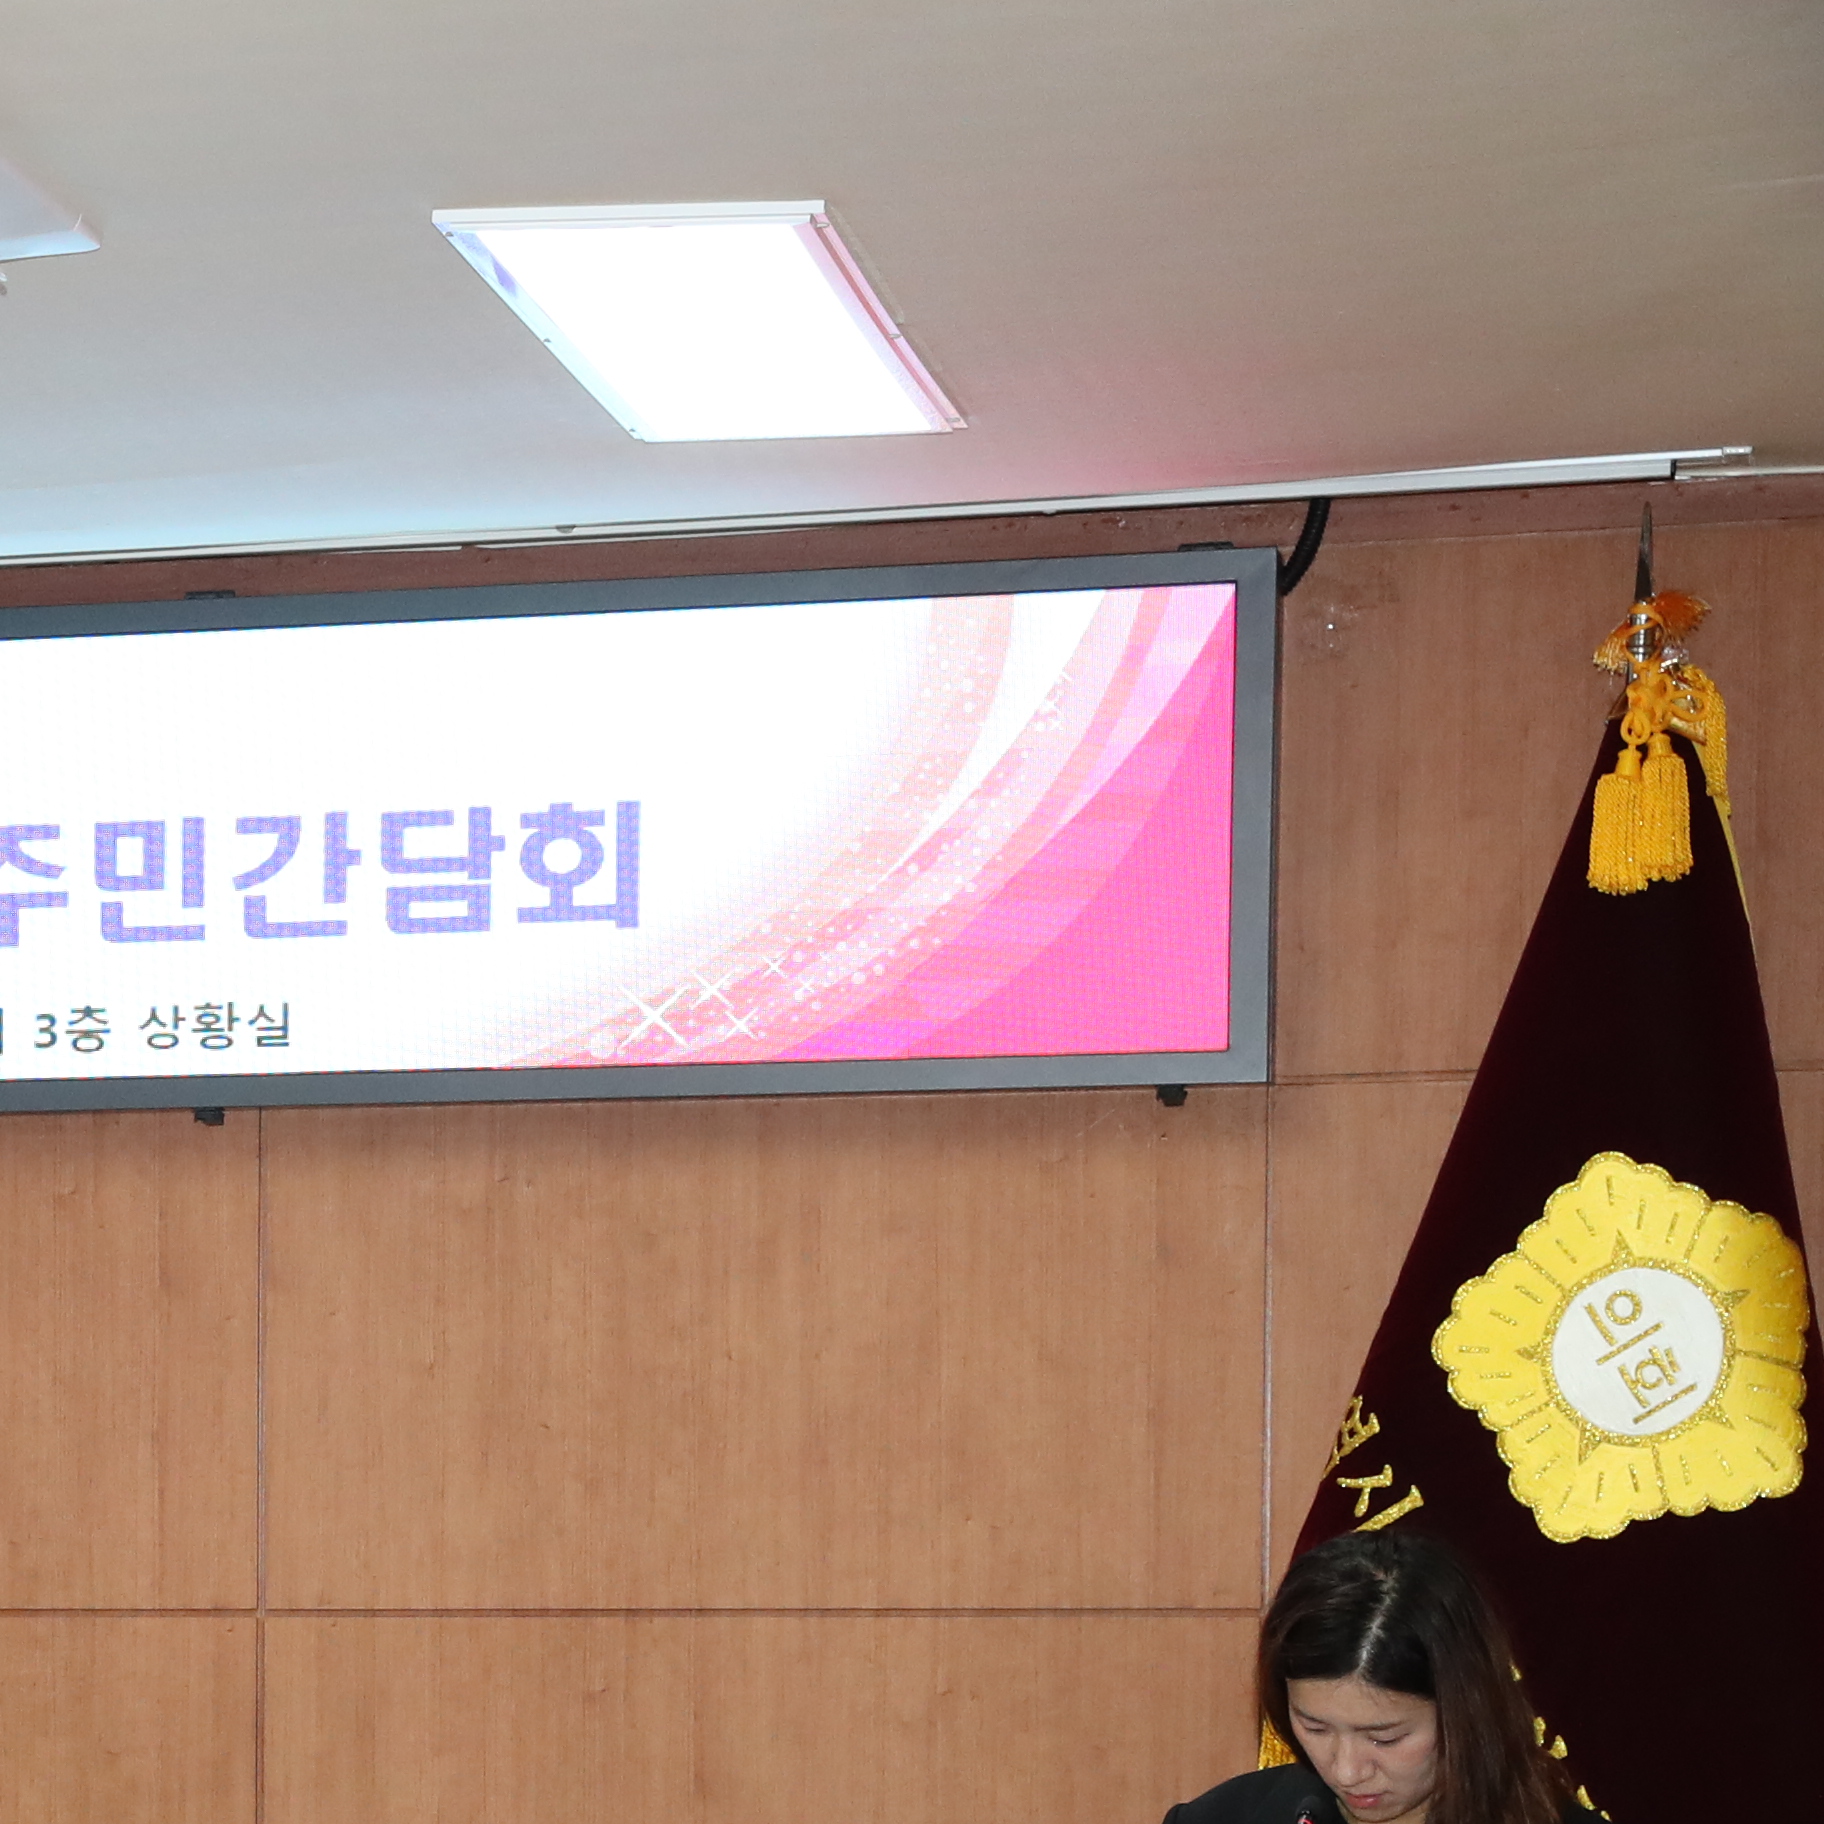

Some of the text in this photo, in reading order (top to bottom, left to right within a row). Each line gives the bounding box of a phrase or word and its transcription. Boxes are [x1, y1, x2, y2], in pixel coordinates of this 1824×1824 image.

[34, 1005, 111, 1054] 3층
[140, 1002, 289, 1050] 상황실
[1583, 1288, 1698, 1424] 의회
